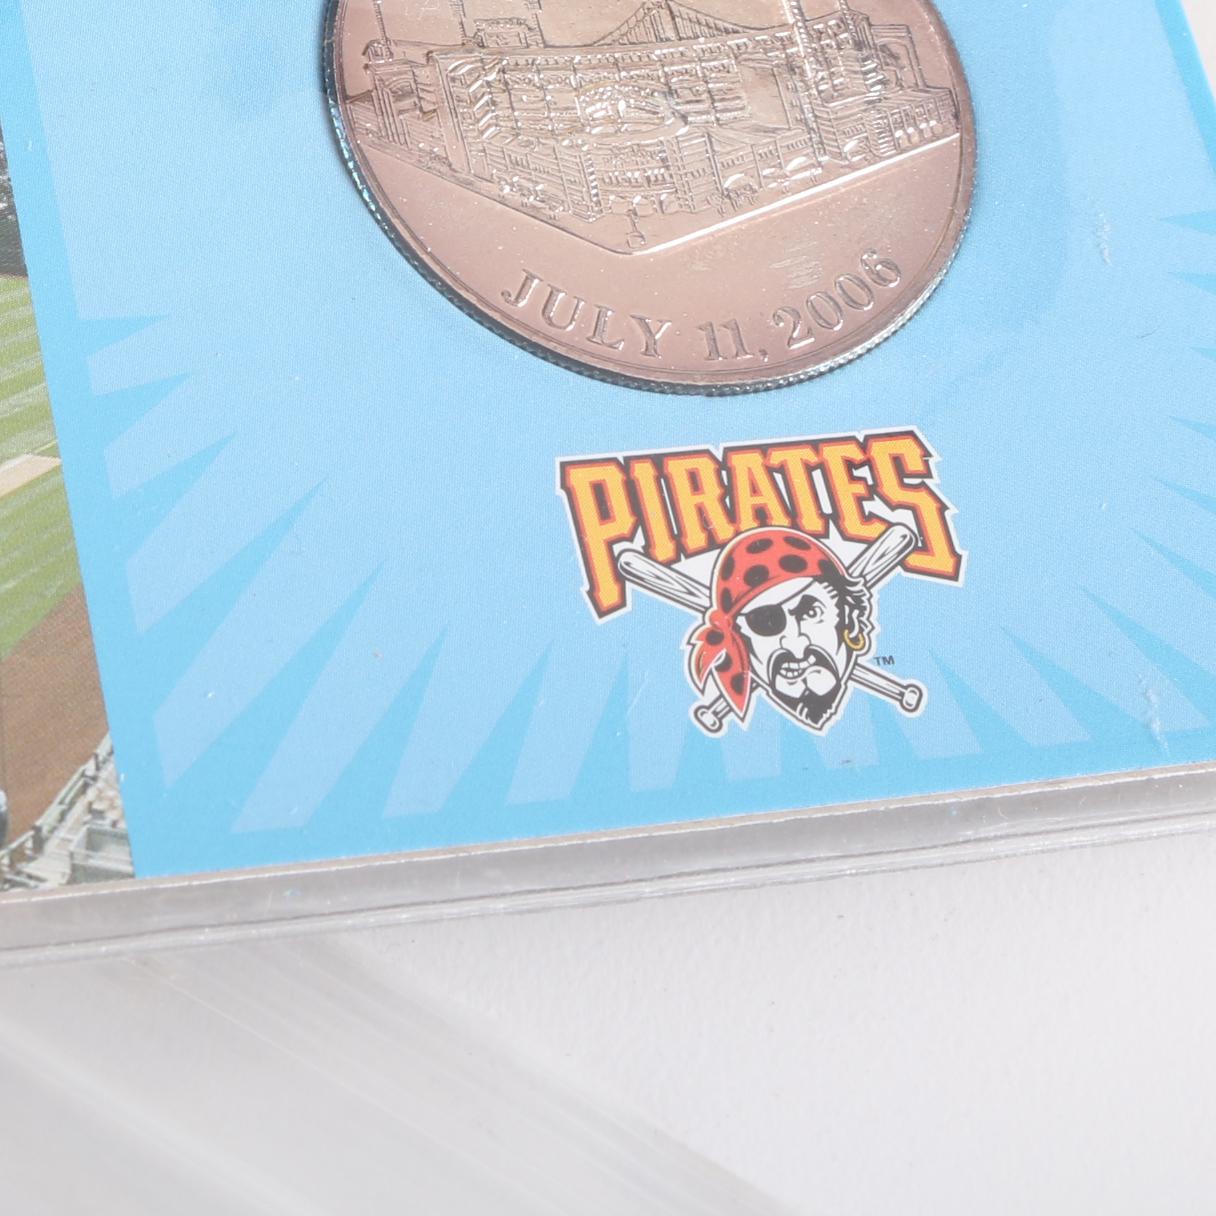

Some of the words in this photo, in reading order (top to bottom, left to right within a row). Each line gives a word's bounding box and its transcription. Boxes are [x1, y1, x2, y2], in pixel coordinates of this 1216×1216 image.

[501, 269, 671, 360] JULY
[698, 319, 768, 362] 11,
[773, 250, 902, 347] 2006
[559, 429, 962, 619] PIRATES
[874, 656, 896, 666] TM
